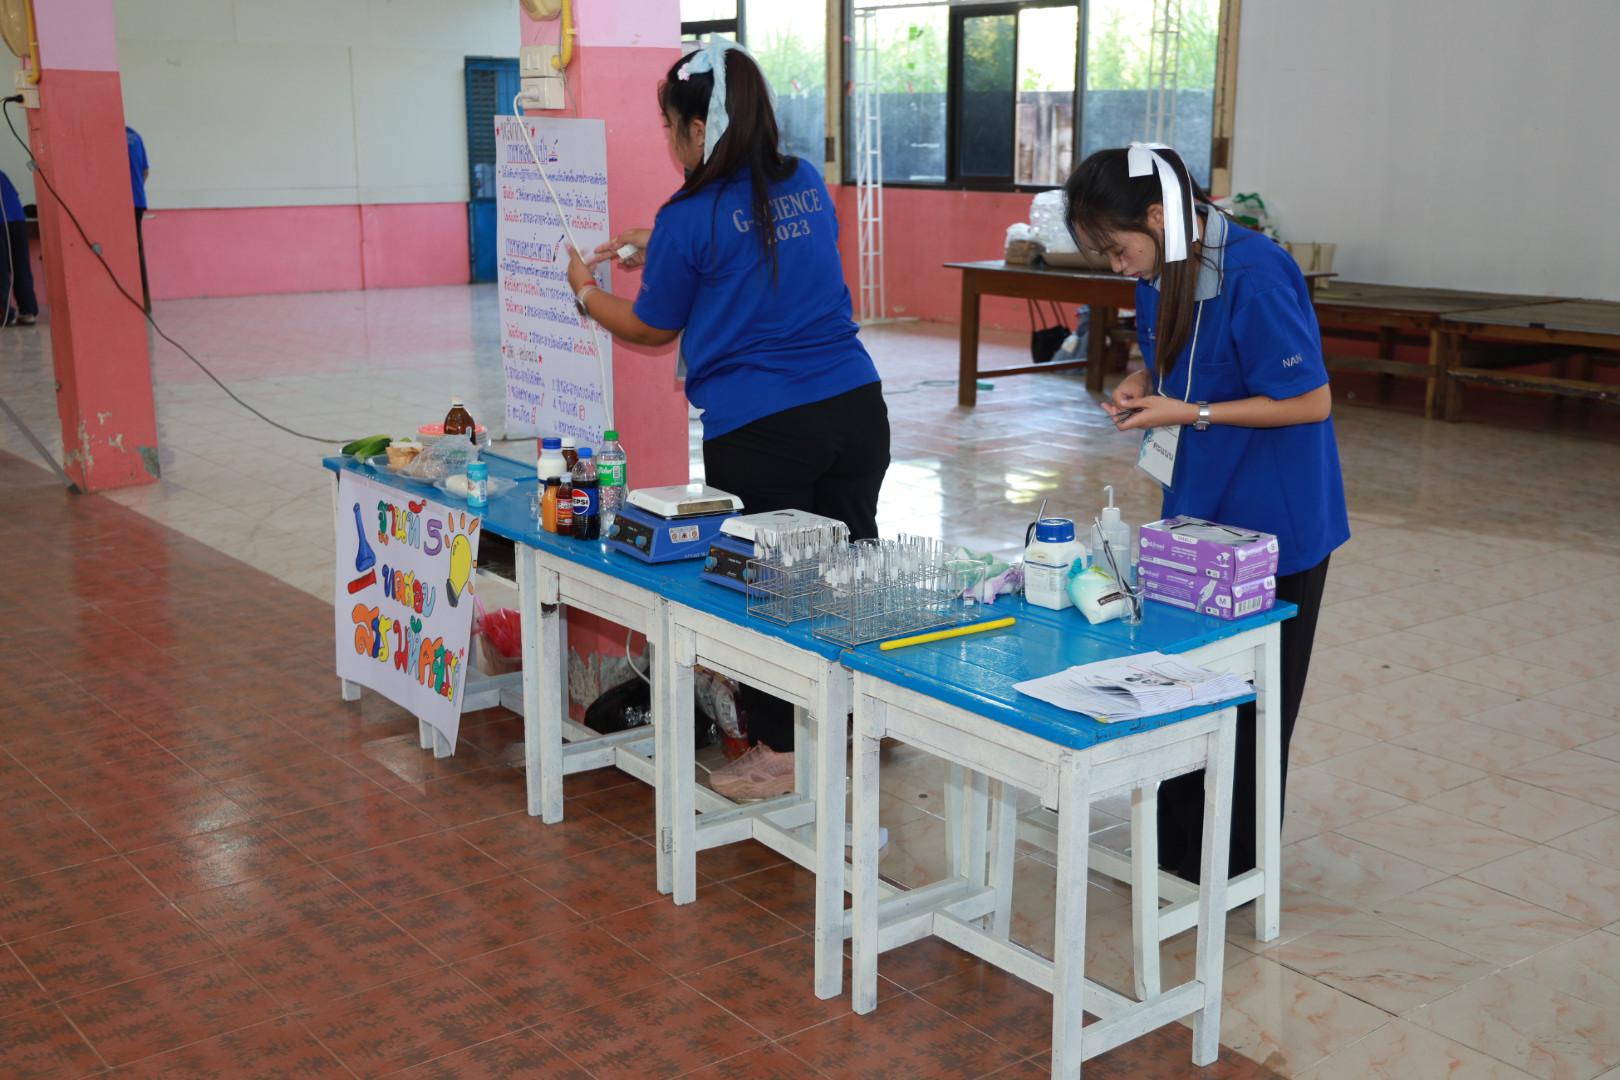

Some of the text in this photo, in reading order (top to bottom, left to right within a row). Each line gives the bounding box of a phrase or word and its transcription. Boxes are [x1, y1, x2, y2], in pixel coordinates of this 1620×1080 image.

[732, 188, 823, 233] G-CIENCE
[377, 499, 443, 556] ฐานที่ 5
[382, 564, 436, 618] ทดสอบ
[1219, 597, 1227, 605] M
